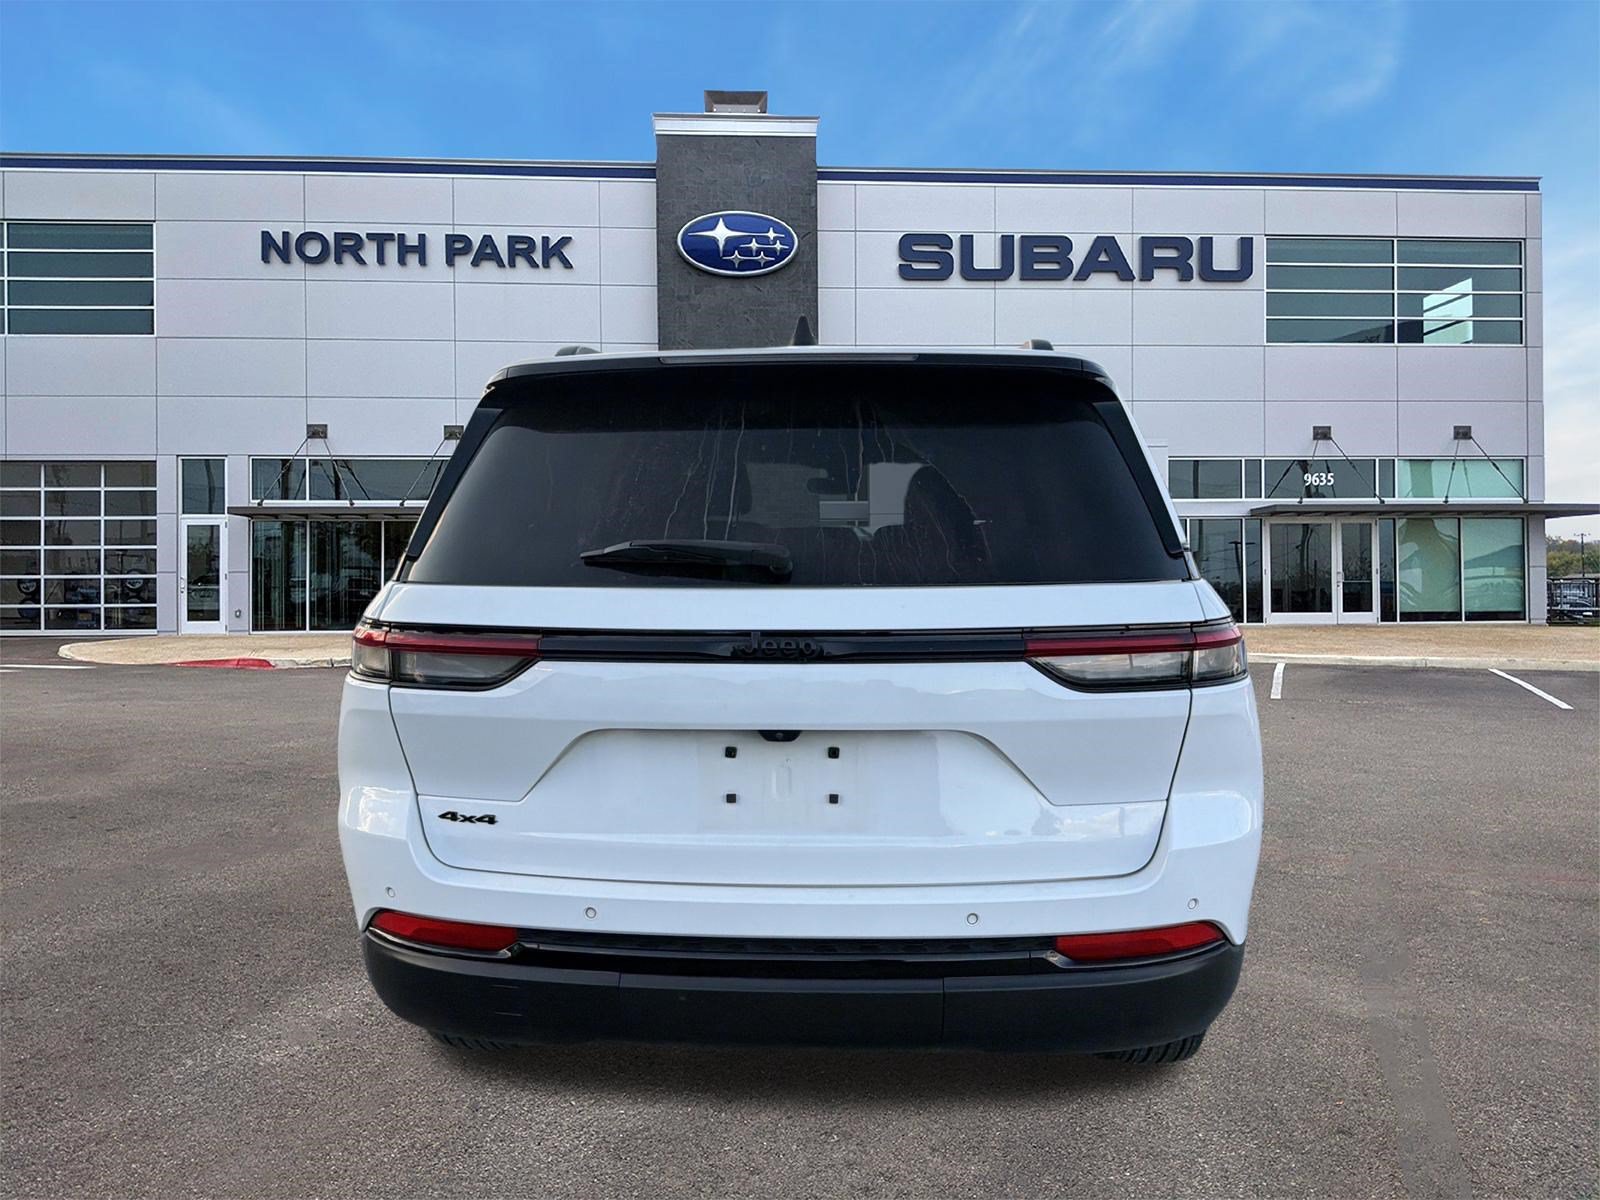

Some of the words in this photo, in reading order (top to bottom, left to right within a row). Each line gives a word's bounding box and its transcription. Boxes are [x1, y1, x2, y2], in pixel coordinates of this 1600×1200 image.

[260, 230, 428, 265] NORTH
[445, 234, 574, 269] PARK
[898, 233, 1254, 282] SUBARU
[1303, 472, 1335, 486] 9635
[740, 631, 817, 659] Jeep
[438, 810, 499, 825] 4x4
